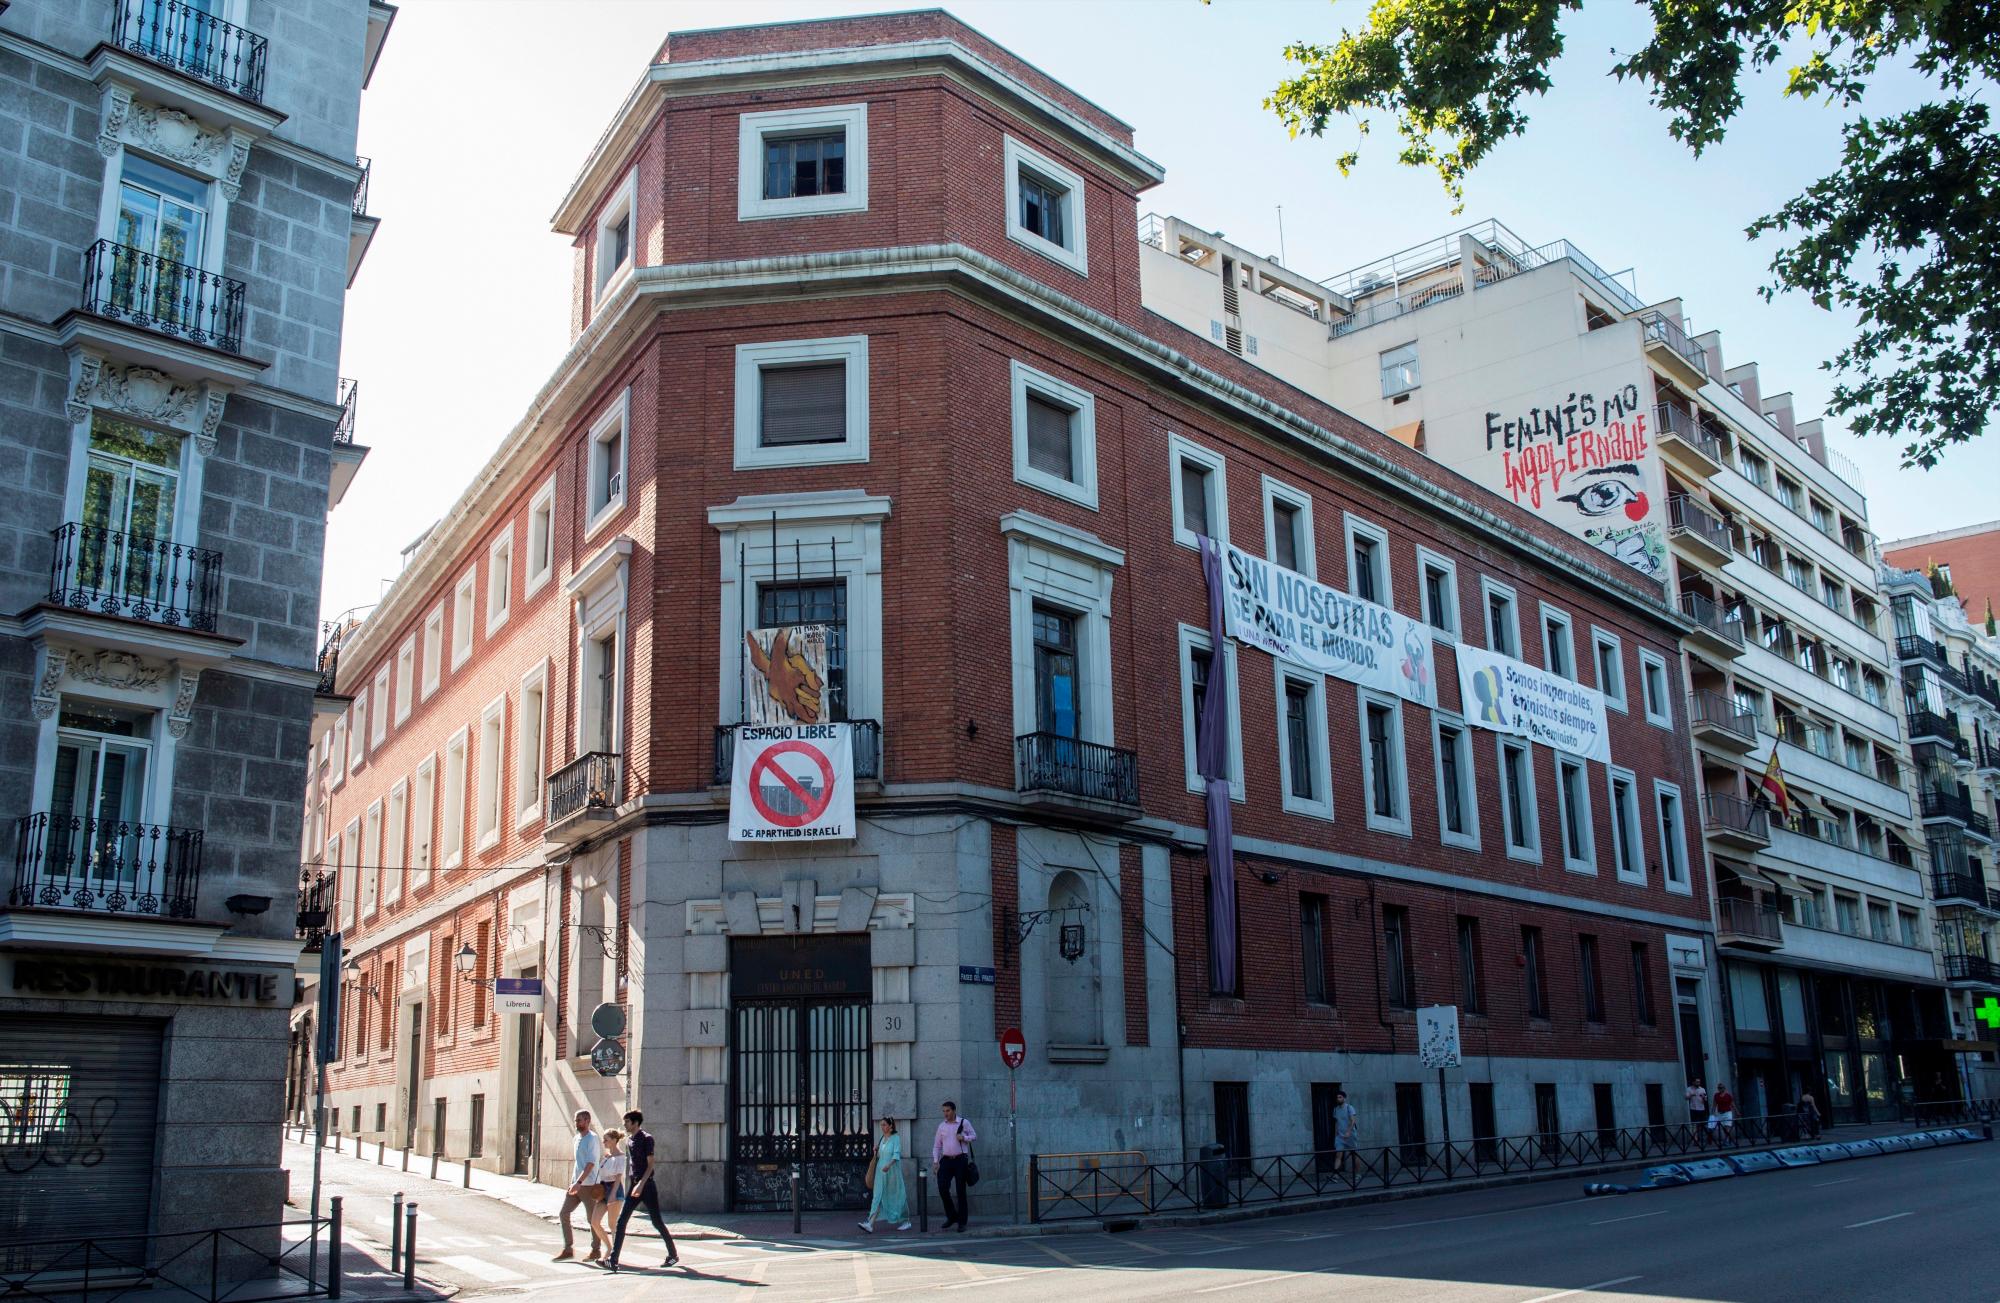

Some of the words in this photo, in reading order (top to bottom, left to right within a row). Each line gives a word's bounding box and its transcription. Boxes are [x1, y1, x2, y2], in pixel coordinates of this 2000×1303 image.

[1227, 549, 1270, 604] SIN
[1276, 570, 1395, 650] NOSOTRAS
[1231, 592, 1252, 624] SE
[1299, 622, 1319, 652] EL
[1321, 630, 1379, 671] MUNDO.
[1506, 665, 1539, 692] Somos
[1540, 676, 1594, 716] imparables,
[741, 829, 754, 838] DE
[13, 960, 279, 1001] RESTAURANTE
[779, 967, 825, 981] UNED
[885, 1016, 902, 1031] 30
